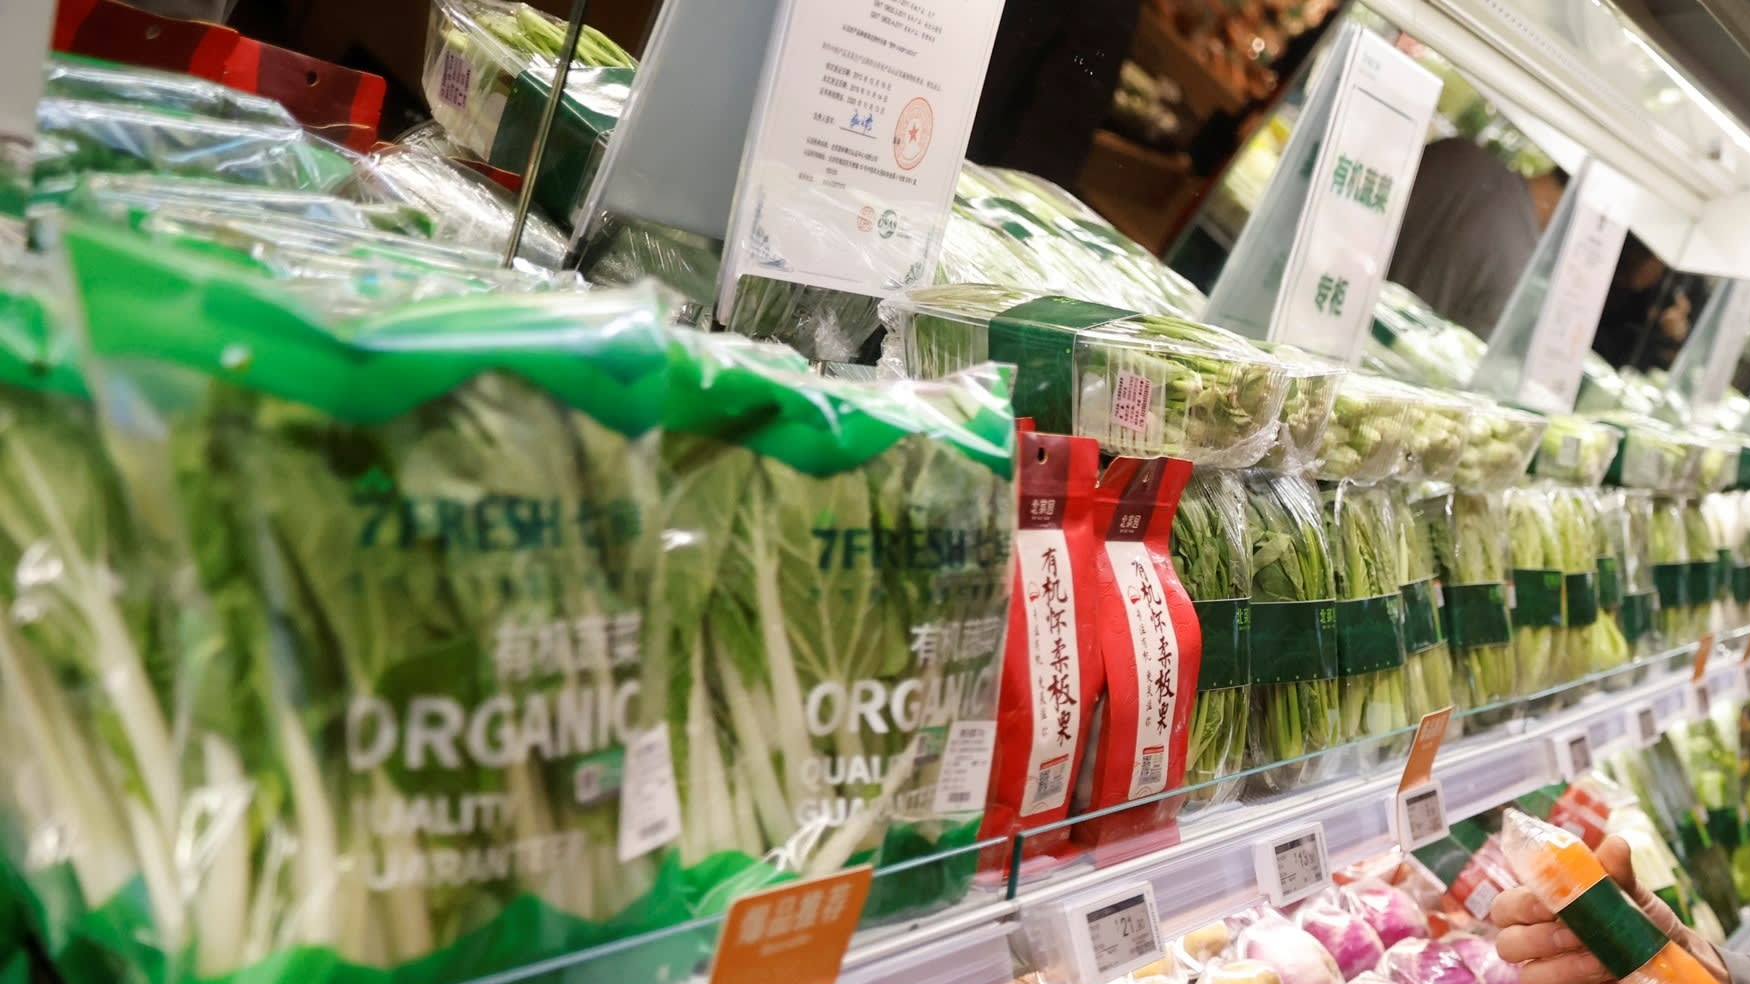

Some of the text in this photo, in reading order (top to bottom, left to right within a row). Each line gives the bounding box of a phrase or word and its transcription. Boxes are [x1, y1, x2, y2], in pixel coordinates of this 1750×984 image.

[1330, 152, 1393, 216] 有机蔬菜
[347, 680, 643, 771] ORGANIC
[806, 672, 987, 737] ORGANIC
